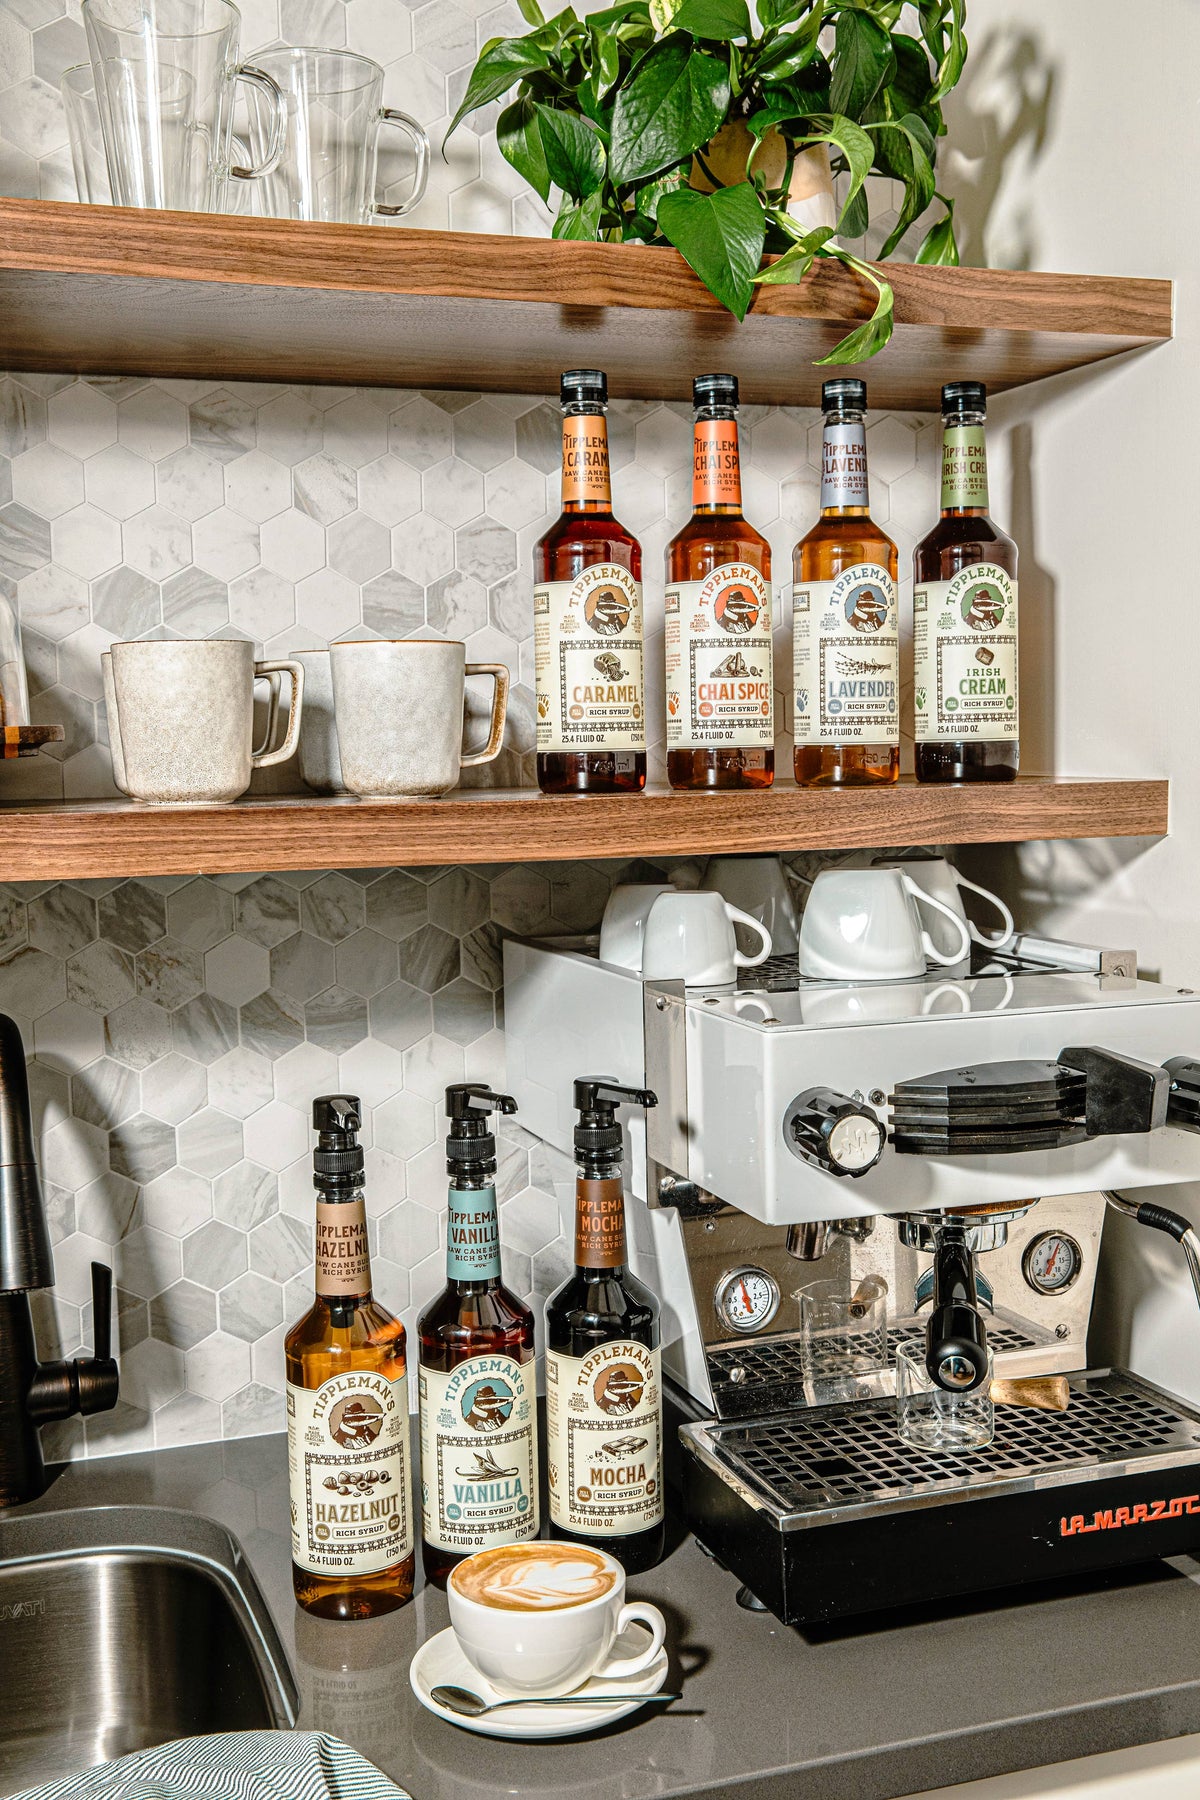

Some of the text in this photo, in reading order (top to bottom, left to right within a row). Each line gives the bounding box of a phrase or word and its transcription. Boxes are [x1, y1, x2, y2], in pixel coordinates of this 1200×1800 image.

[696, 455, 721, 471] CHAI
[944, 462, 966, 476] IRISH
[569, 567, 638, 608] TIPPLEMAN'S
[699, 567, 768, 607] TIPPLEMAN'S
[829, 567, 895, 606] TIPPLEMAN'S
[946, 567, 1013, 605] TIPPLEMAN'S
[967, 668, 1000, 676] IRISH
[573, 685, 638, 704] CARAMEL
[698, 683, 768, 701] CHAI SPICE
[828, 681, 895, 698] LAVENDER
[959, 678, 1006, 695] CREAM
[562, 735, 574, 743] 25.4
[576, 734, 594, 743] FLUID
[578, 1196, 623, 1213] IPPLEMA
[582, 1213, 623, 1232] MOCHA
[577, 1345, 653, 1387] TIPPLEMAN'S
[445, 1360, 525, 1402] TIPPLEMAN'S
[313, 1376, 395, 1419] TIPPLEMAN'S
[590, 1463, 647, 1486] MOCHA
[453, 1478, 523, 1504] VANILLA
[597, 1492, 616, 1500] RICH
[619, 1488, 642, 1498] SYRUP
[315, 1495, 398, 1523] HAZELNUT
[489, 1506, 514, 1516] SYRUP
[569, 1515, 615, 1527] 25.4 FLUID OZ.
[1060, 1515, 1085, 1536] LA
[336, 1529, 356, 1537] RICH
[358, 1525, 384, 1535] SYRUP
[440, 1533, 486, 1545] 25.4 FLUID OZ.
[515, 1527, 527, 1539] (750
[309, 1554, 355, 1566] 25.4 FLUID OZ.
[386, 1547, 398, 1559] (750
